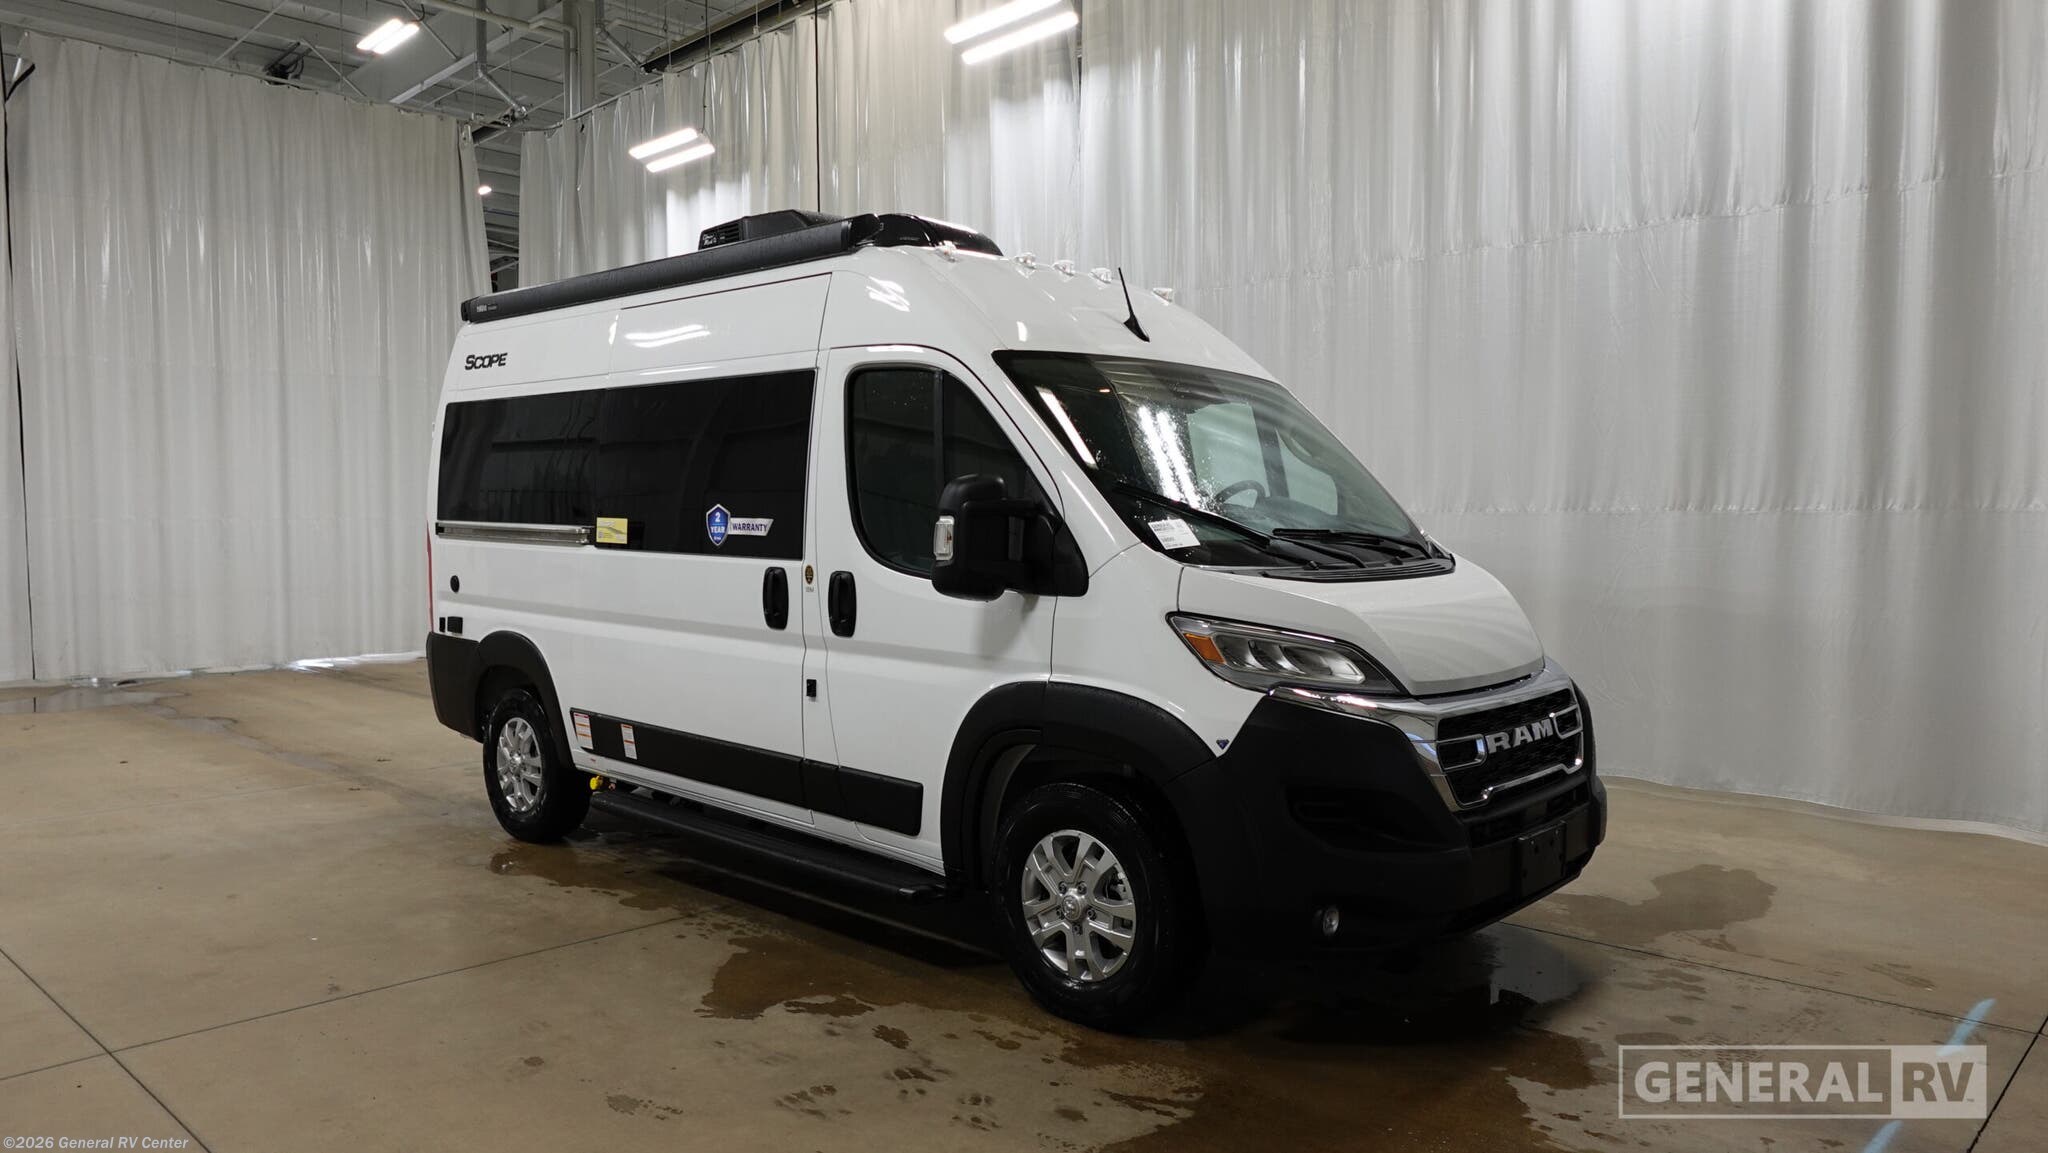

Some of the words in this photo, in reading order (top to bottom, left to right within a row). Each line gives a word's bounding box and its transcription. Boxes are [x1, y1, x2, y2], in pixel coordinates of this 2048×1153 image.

[715, 512, 721, 522] 2
[710, 526, 726, 534] YEAR
[732, 522, 768, 532] WARRANTY
[1485, 719, 1553, 753] RAM
